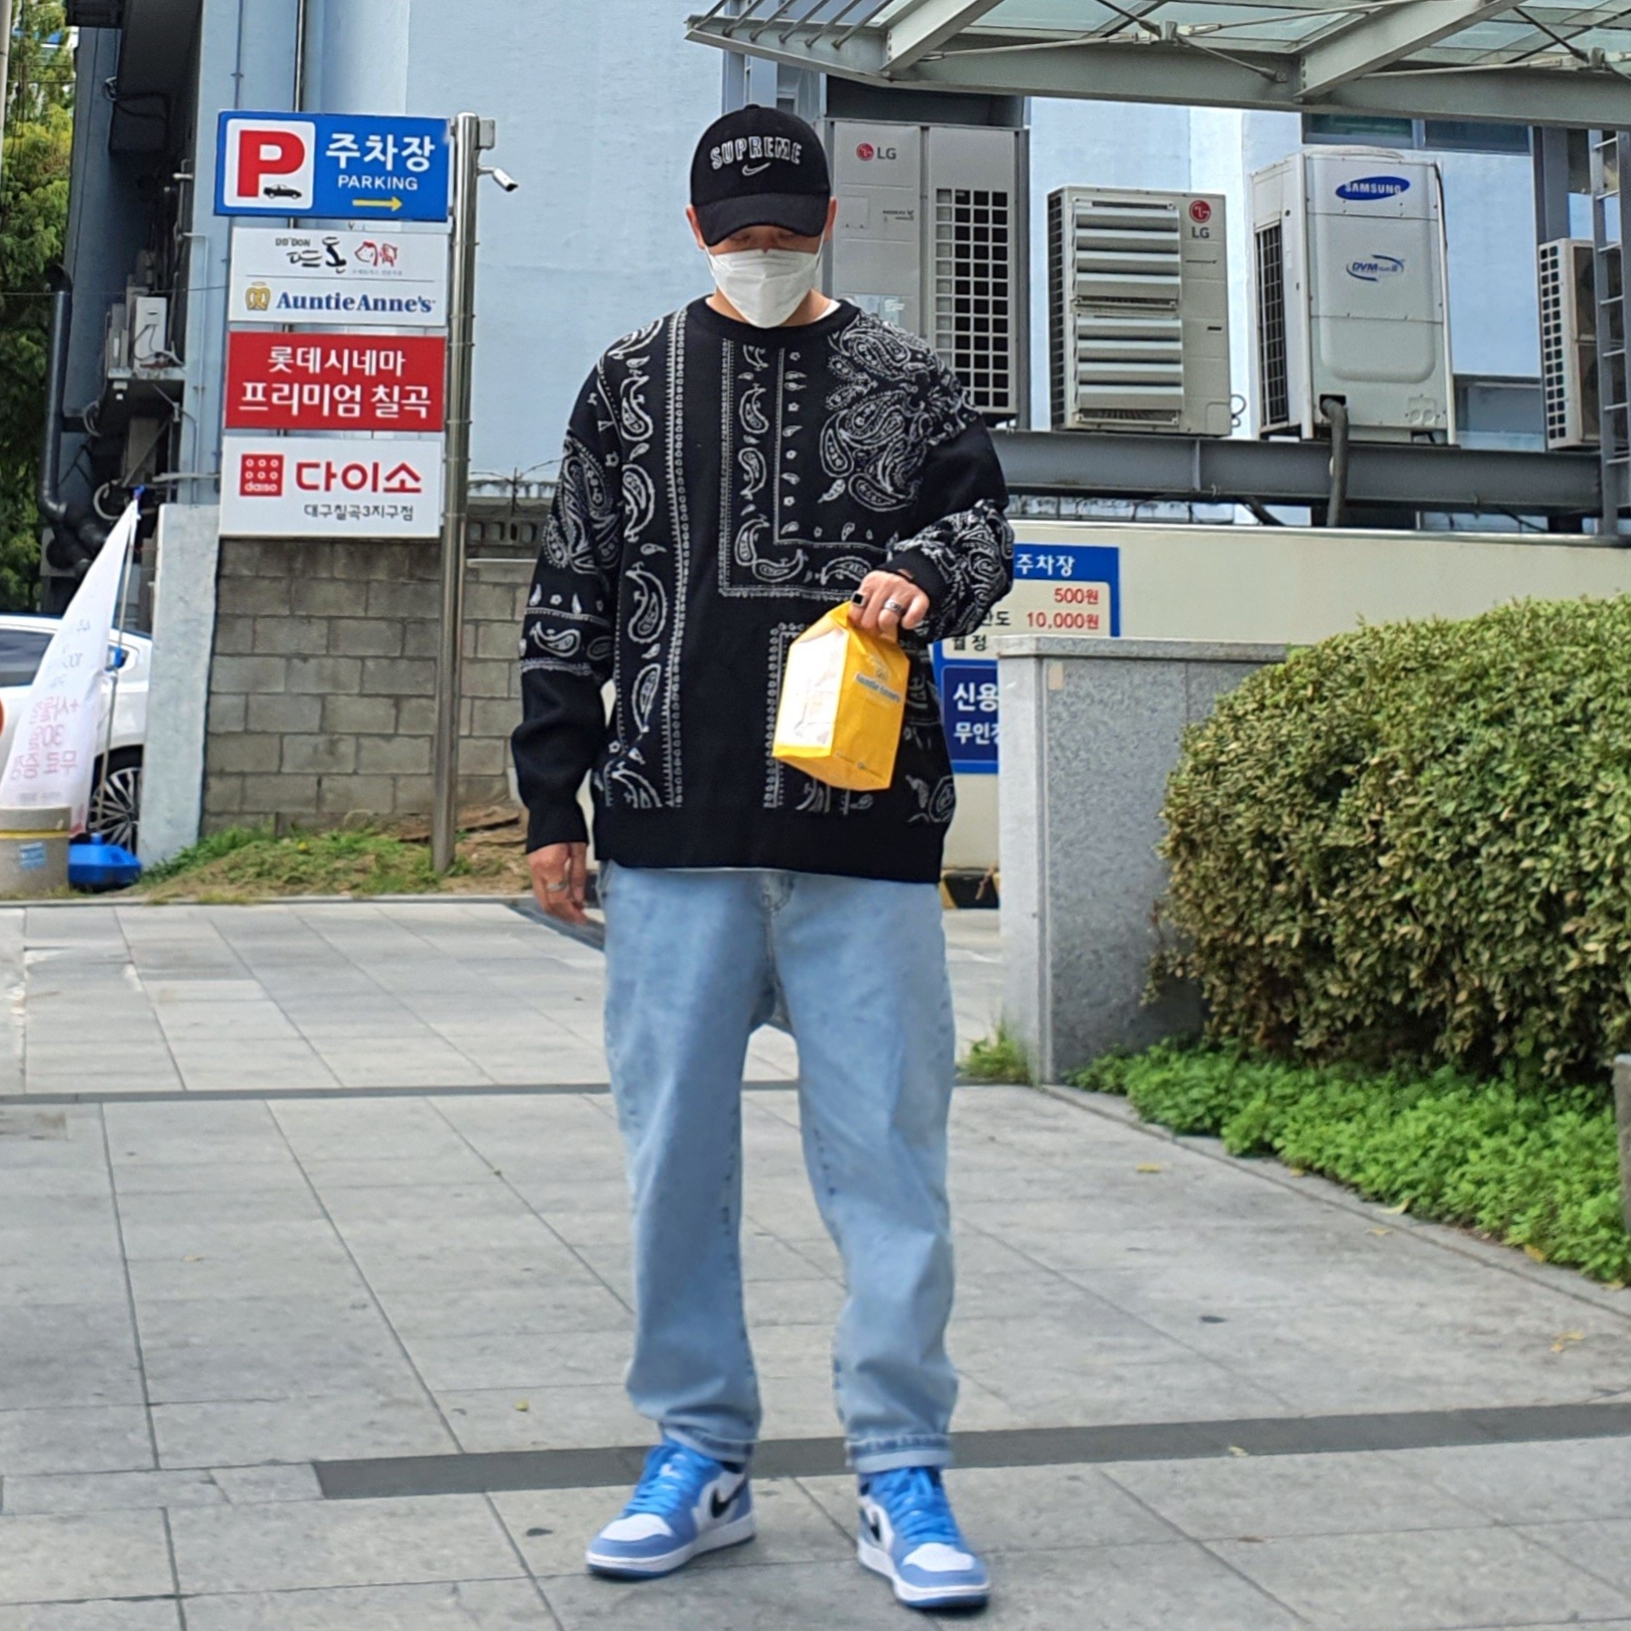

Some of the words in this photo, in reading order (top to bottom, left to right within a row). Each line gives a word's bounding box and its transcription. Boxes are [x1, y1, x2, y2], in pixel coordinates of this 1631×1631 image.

[325, 133, 435, 172] 주차장
[710, 136, 802, 170] SUPREME
[876, 147, 897, 160] LG
[237, 130, 305, 197] P
[337, 175, 418, 191] PARKING
[1345, 182, 1402, 195] SAMSUNG
[1191, 226, 1210, 239] LG
[1352, 262, 1378, 271] DVM
[268, 346, 406, 376] 롯데시네마
[239, 382, 361, 418] 프리미엄
[370, 385, 431, 419] 칠곡
[296, 461, 422, 494] 다이소
[244, 481, 278, 492] daiso
[304, 504, 414, 521] 대구칠곡3지구점
[1015, 554, 1076, 577] 주차장
[1054, 587, 1099, 605] 500원
[1026, 612, 1099, 629] 10,000원
